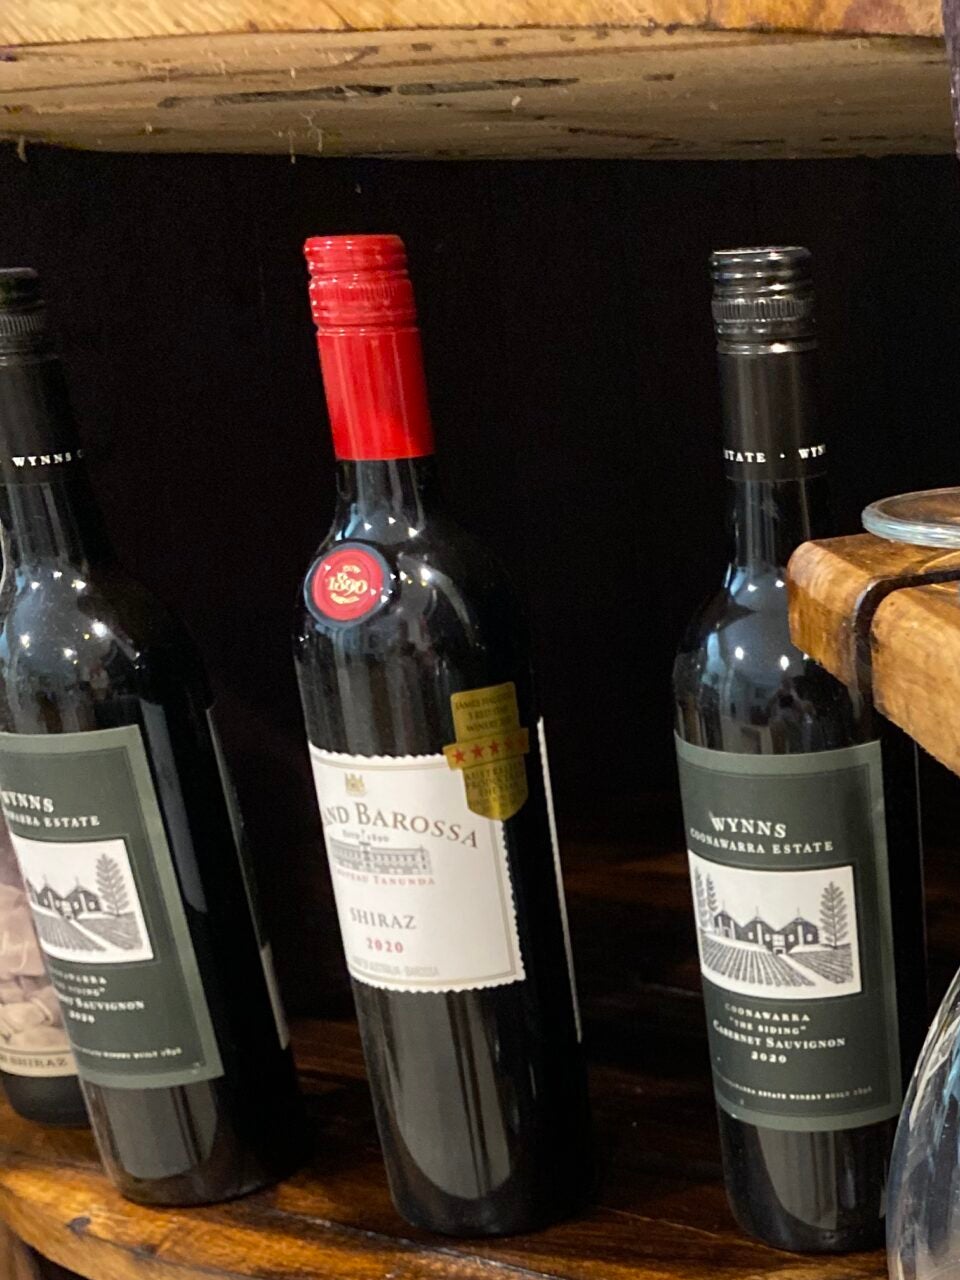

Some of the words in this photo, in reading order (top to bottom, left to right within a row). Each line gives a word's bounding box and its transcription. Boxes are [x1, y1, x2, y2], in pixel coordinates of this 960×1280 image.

[12, 452, 72, 467] WYNNS
[328, 572, 368, 596] 1890
[44, 815, 100, 828] ESTATE
[355, 802, 478, 849] BAROSSA
[711, 817, 787, 839] WYNNS
[690, 828, 765, 854] COONAWARRA
[772, 841, 833, 854] ESTATE
[373, 875, 436, 886] TANUNDA
[350, 907, 416, 930] SHIRAZ
[366, 937, 404, 954] 2020
[724, 1002, 811, 1022] COONAWARRA
[10, 1055, 67, 1069] SHIRAZ
[751, 1050, 787, 1064] 2020
